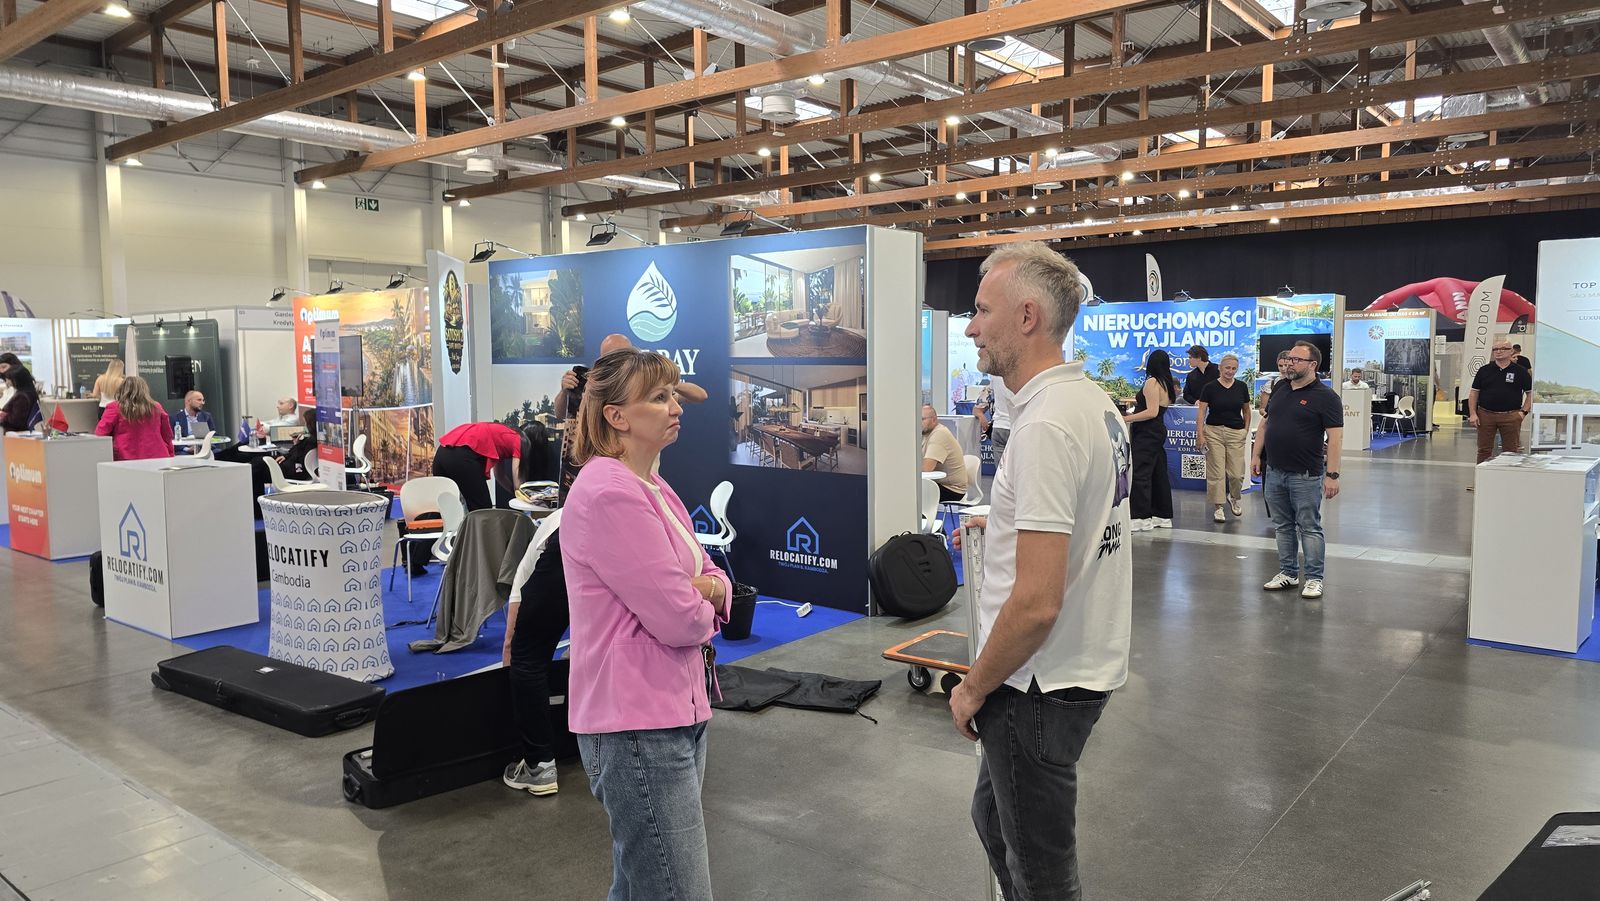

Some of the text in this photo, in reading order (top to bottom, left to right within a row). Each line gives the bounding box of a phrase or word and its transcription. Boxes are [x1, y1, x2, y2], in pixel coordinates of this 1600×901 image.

[300, 306, 339, 325] Optimum
[1083, 306, 1251, 332] NIERUCHOMOŚCI
[1475, 291, 1492, 350] IZODOM
[1108, 330, 1236, 348] W TAJLANDII
[191, 359, 202, 373] EN
[303, 354, 312, 365] RE
[1167, 430, 1198, 438] IERUCH
[1169, 438, 1177, 446] W
[1101, 520, 1122, 542] ONG
[268, 542, 329, 568] ELOCATIFY
[770, 549, 838, 570] RELOCATIFY.COM
[107, 556, 164, 585] RELOCATIFY.COM
[272, 568, 311, 588] Cambodia
